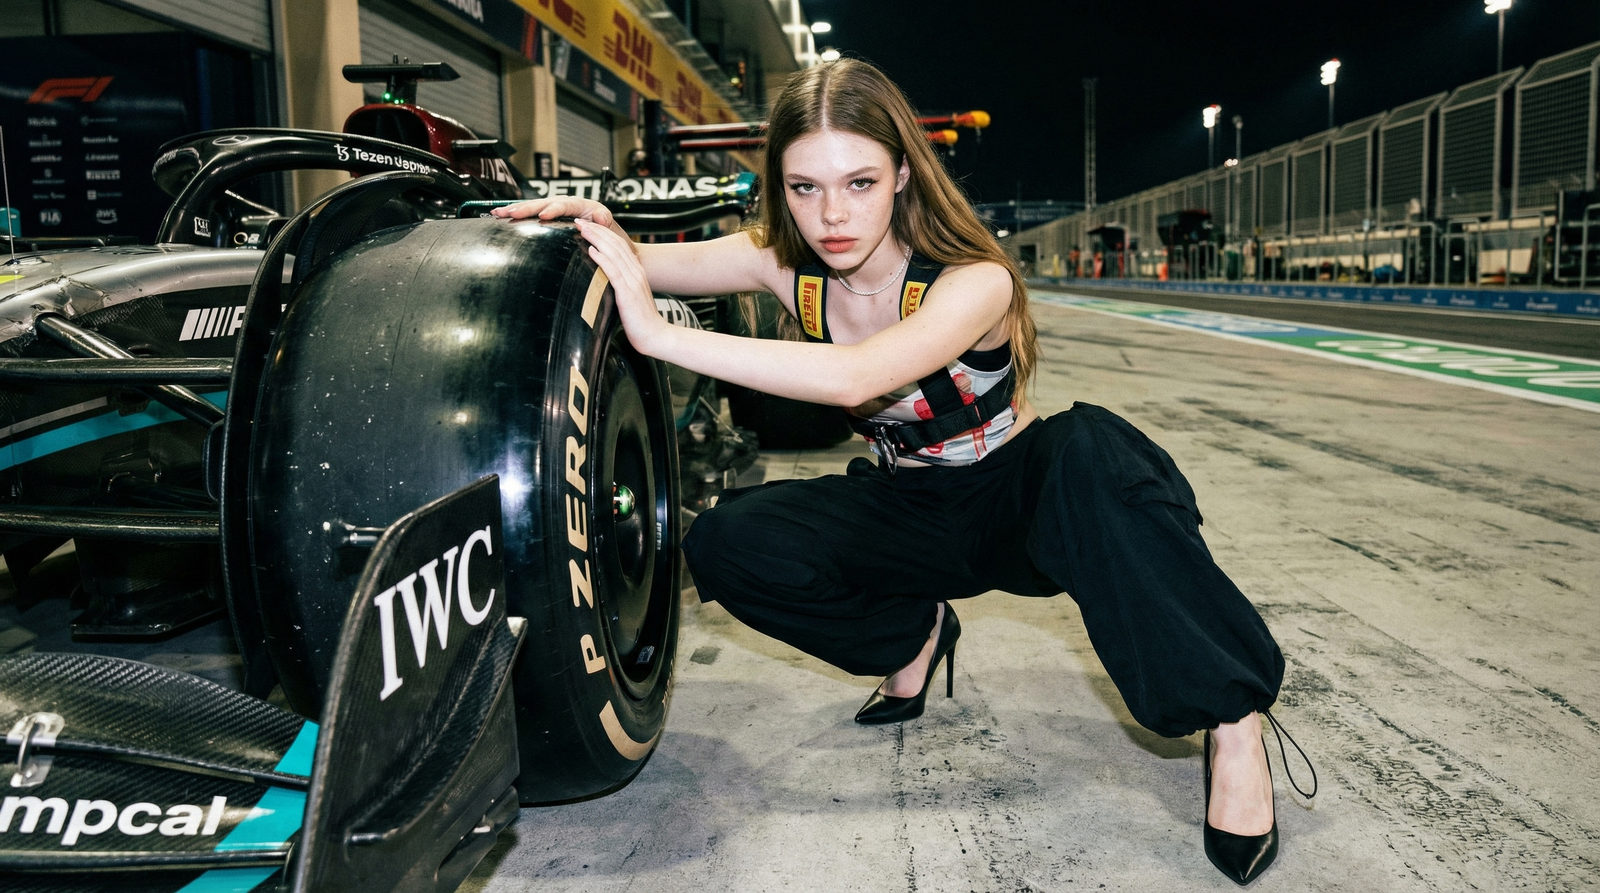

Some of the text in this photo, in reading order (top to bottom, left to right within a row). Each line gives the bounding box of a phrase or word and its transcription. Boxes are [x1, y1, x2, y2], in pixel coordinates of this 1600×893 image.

[352, 147, 393, 165] Tezen
[40, 211, 60, 223] FIA
[96, 208, 117, 218] aws
[565, 365, 607, 675] P ZERO
[373, 525, 496, 701] IWC
[0, 795, 227, 846] mpcal
